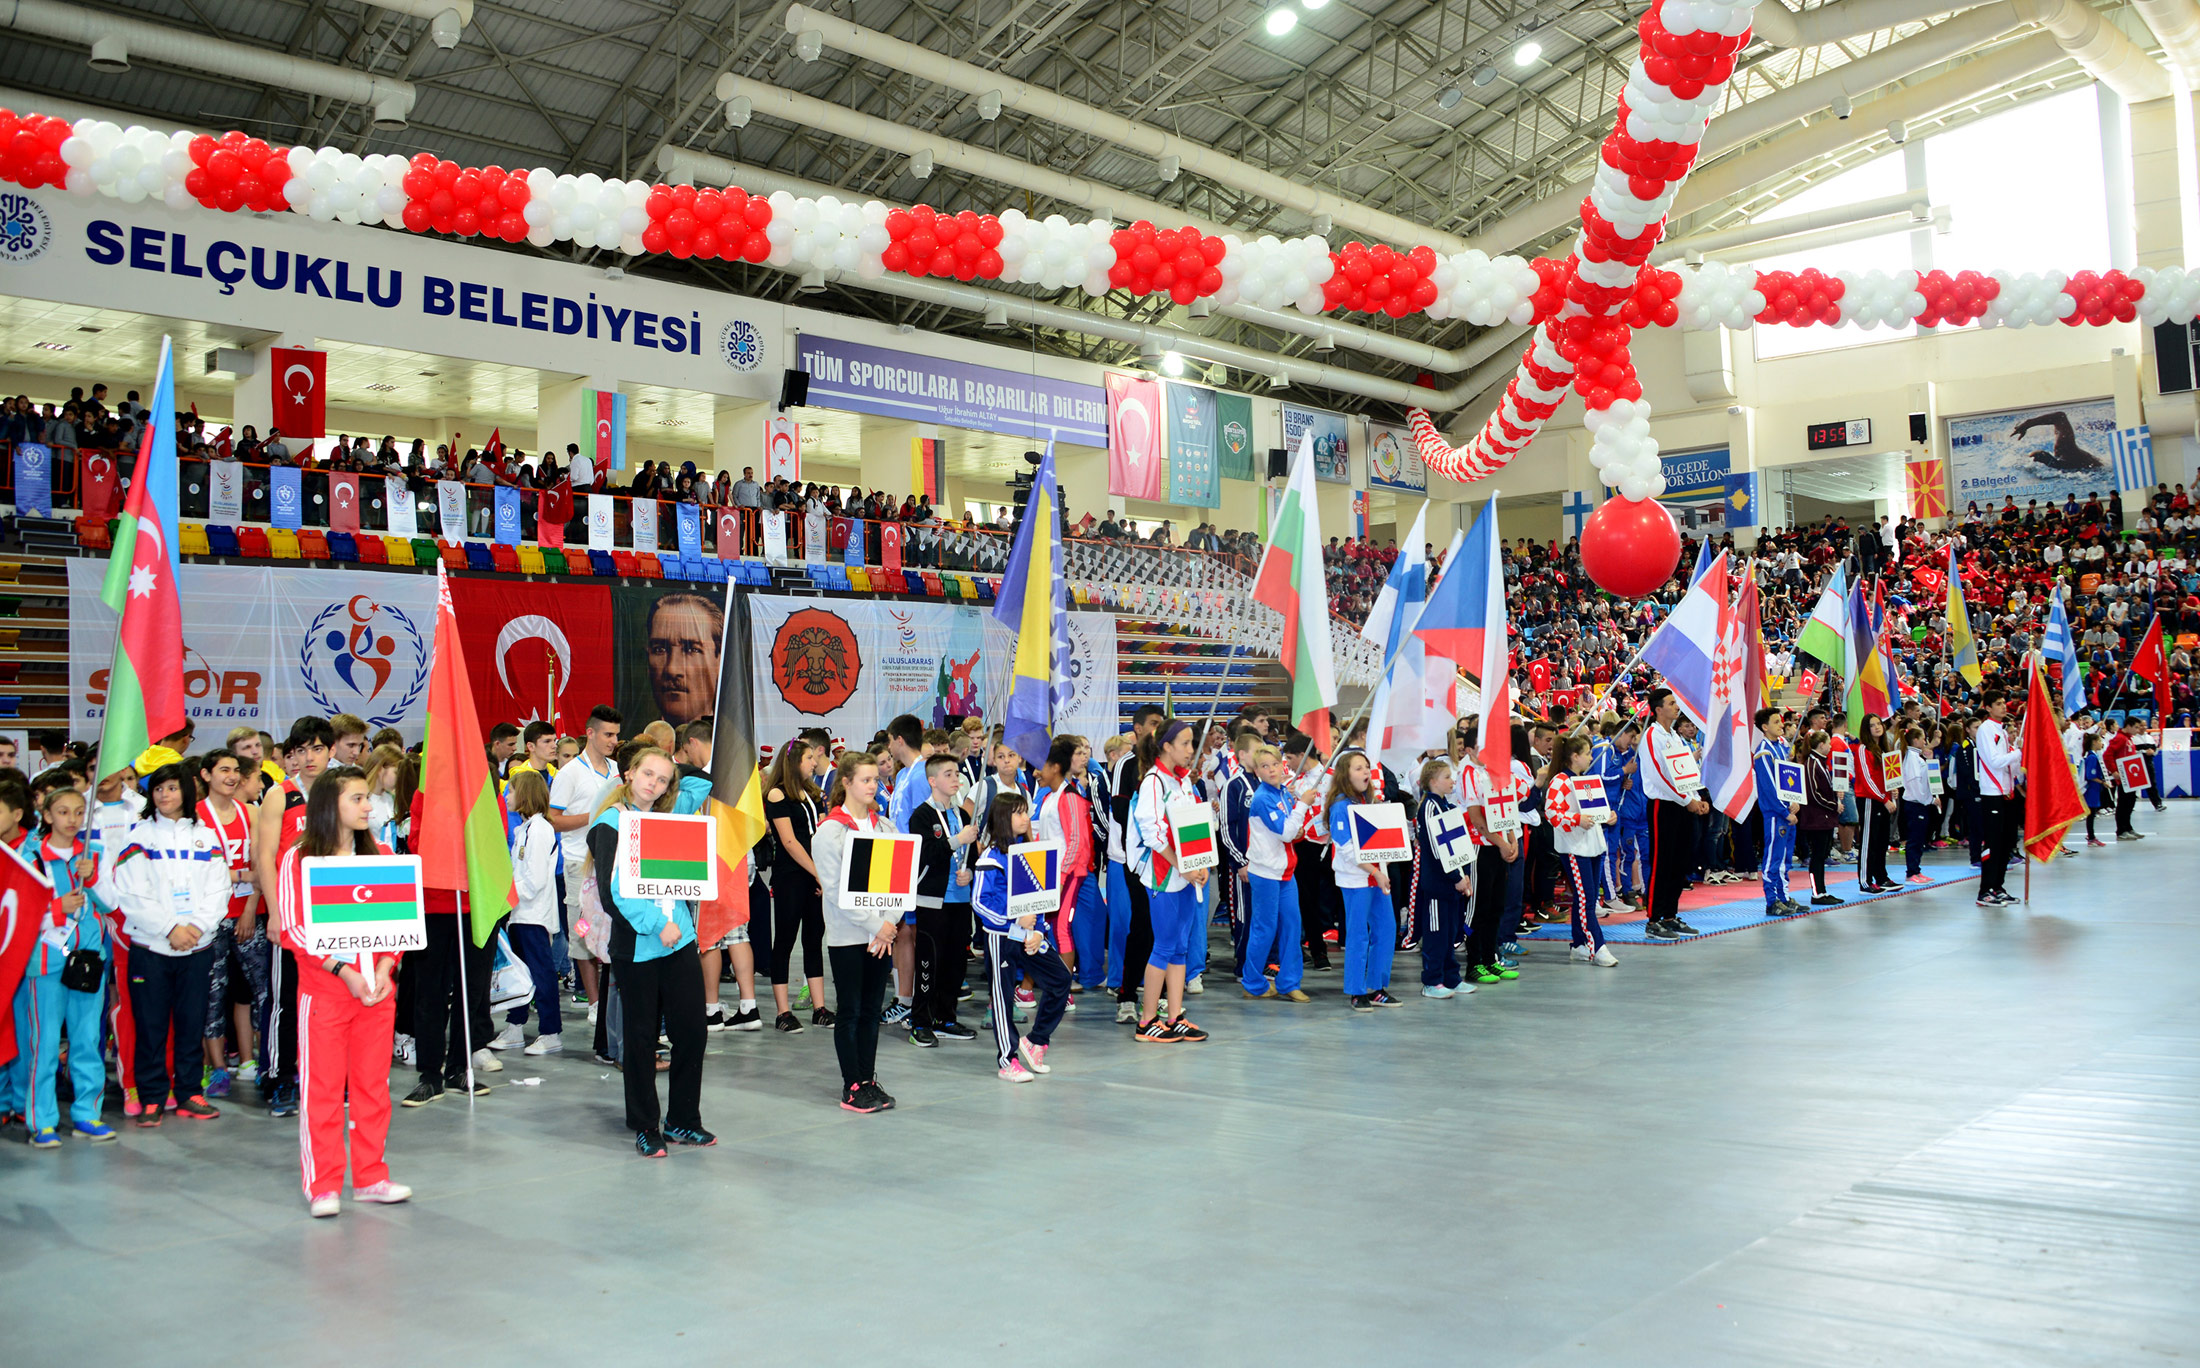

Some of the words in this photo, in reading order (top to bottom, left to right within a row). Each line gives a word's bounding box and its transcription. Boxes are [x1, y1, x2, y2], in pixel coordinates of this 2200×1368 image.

[85, 219, 402, 309] SELÇUKLU
[423, 275, 701, 356] BELEDİYESİ
[802, 350, 843, 383] TÜM
[849, 360, 959, 401] SPORCULARA
[964, 380, 1049, 416] BAŞARILAR
[978, 410, 998, 421] ALTAY
[1285, 423, 1302, 437] 4500
[1317, 440, 1329, 455] 42
[1661, 459, 1710, 477] ÖLGEDE
[1960, 479, 1968, 489] 2
[1971, 474, 2018, 489] Bölgede
[2005, 482, 2055, 496] HAVUZU
[888, 657, 934, 665] ULUSLARARASI
[1067, 618, 1094, 698] BELEDİYESİ
[85, 667, 262, 705] SOR
[889, 684, 903, 692] 19-24
[903, 684, 917, 692] Nisan
[1064, 698, 1082, 719] 1989
[1183, 856, 1213, 869] BULGARIA
[1360, 852, 1378, 861] CZECH
[1379, 850, 1408, 860] REPUBLIC
[637, 883, 701, 897] BELARUS
[854, 896, 903, 908] BELGIUM
[316, 933, 420, 950] AZERBAIJAN
